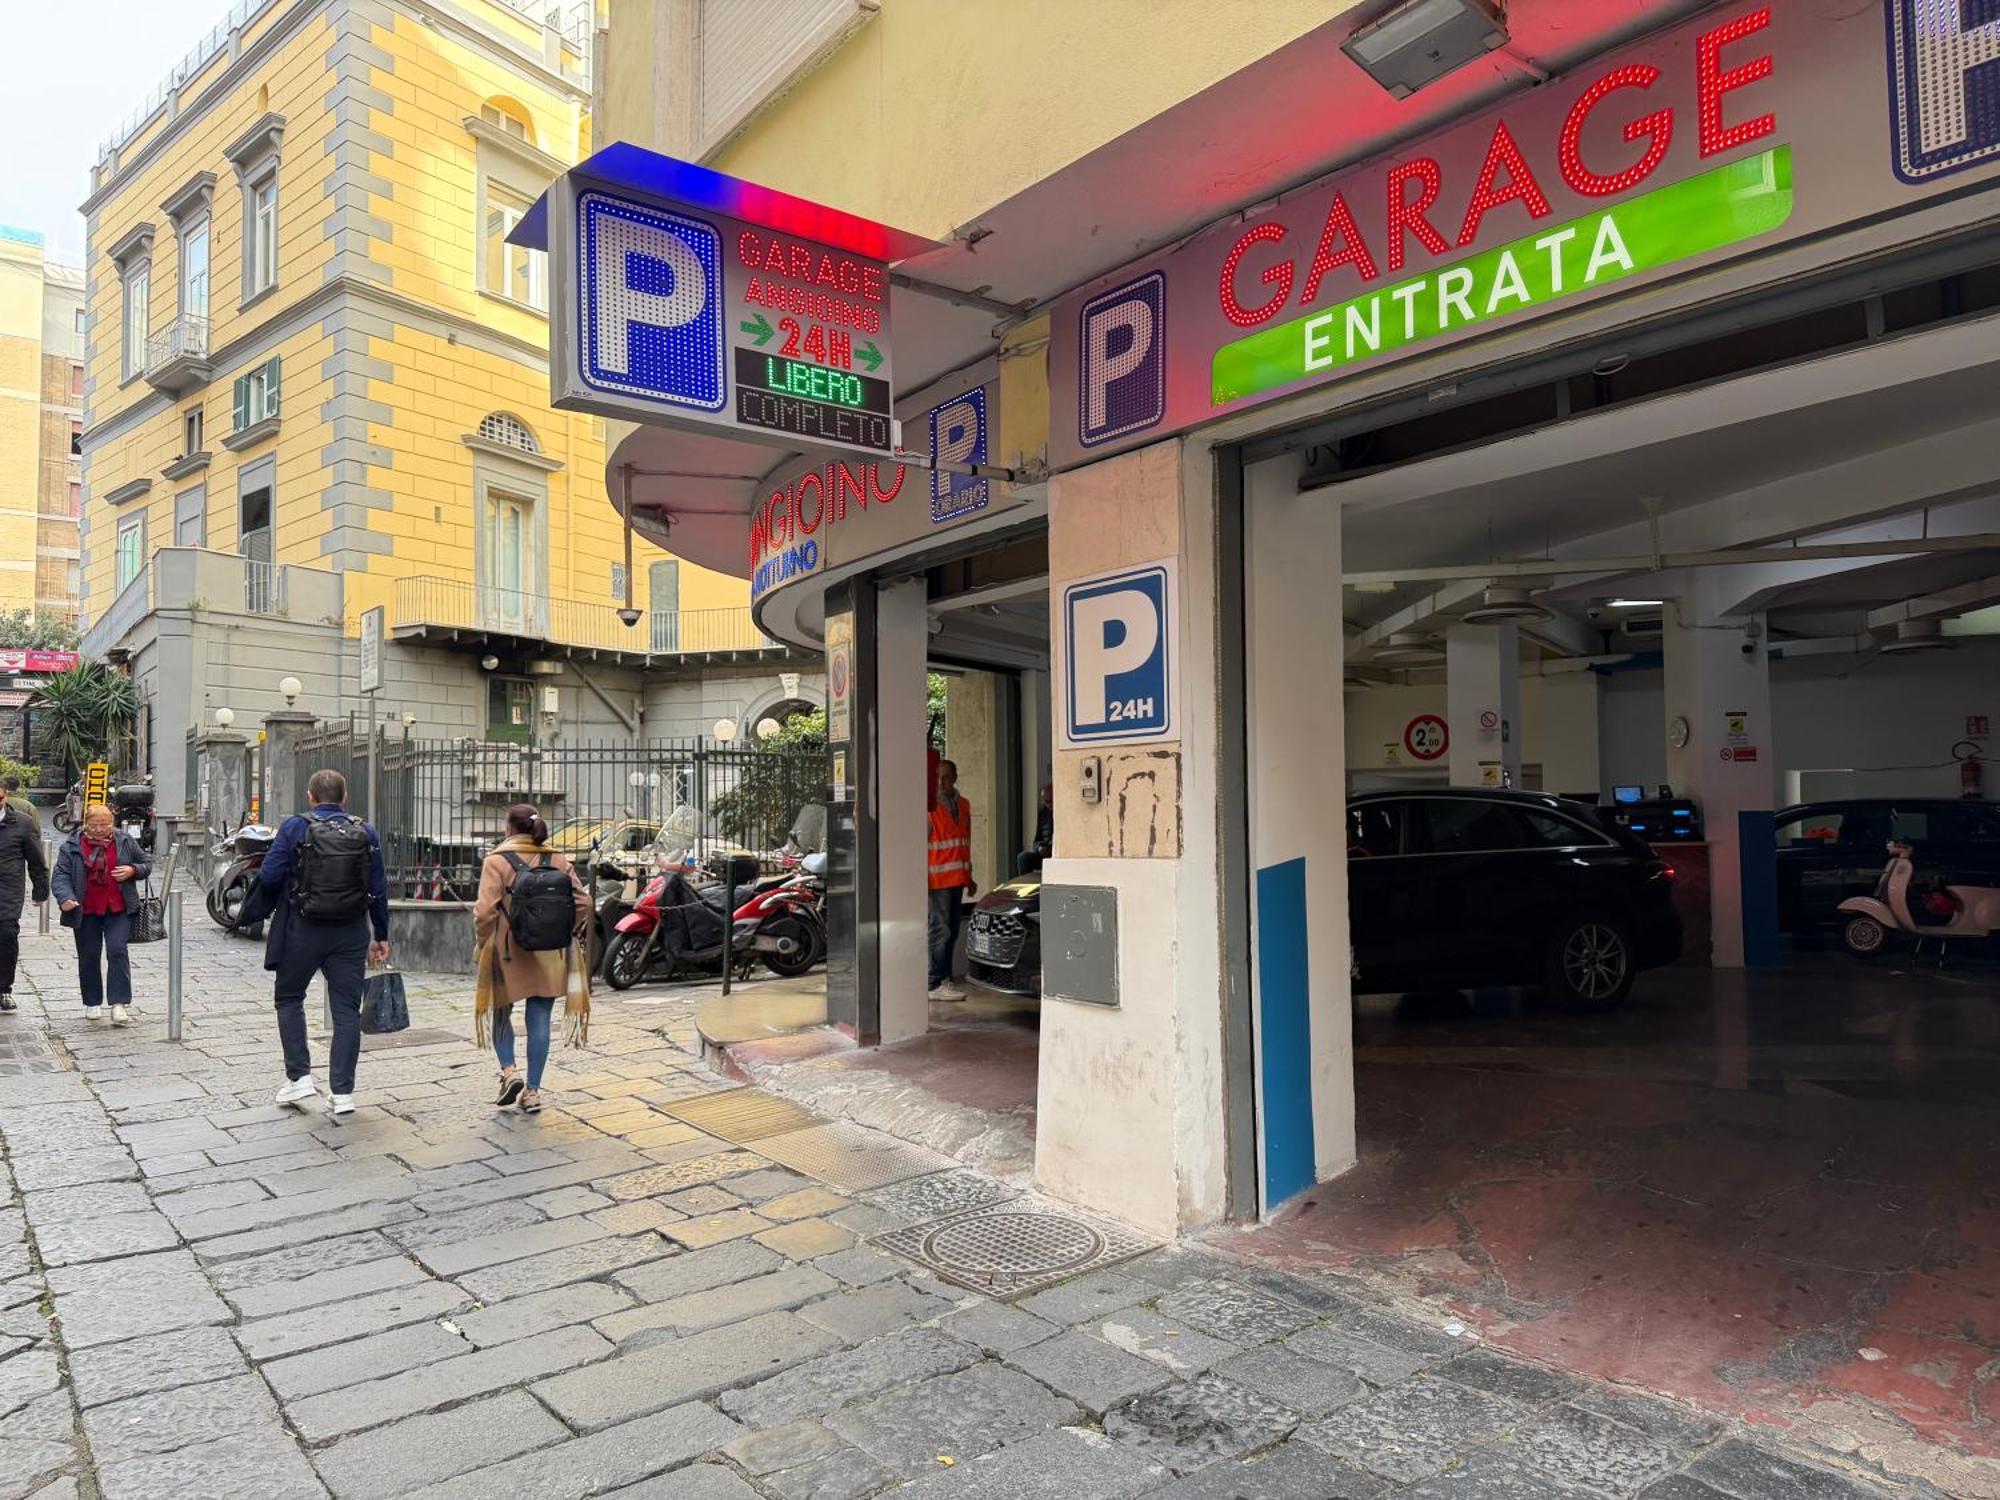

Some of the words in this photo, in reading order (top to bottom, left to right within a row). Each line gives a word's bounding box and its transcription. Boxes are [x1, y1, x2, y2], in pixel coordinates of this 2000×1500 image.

[1217, 5, 1777, 330] GARAGE
[596, 211, 706, 375] P
[737, 231, 882, 302] GARAGE
[744, 277, 881, 335] ANGIOINO
[1303, 213, 1635, 373] ENTRATA
[767, 357, 862, 406] LIBERO
[777, 317, 851, 371] 24H
[1086, 299, 1150, 429] P
[741, 391, 887, 447] COMPLETO
[936, 401, 978, 497] P
[1073, 589, 1158, 726] P
[1108, 697, 1154, 723] 24H
